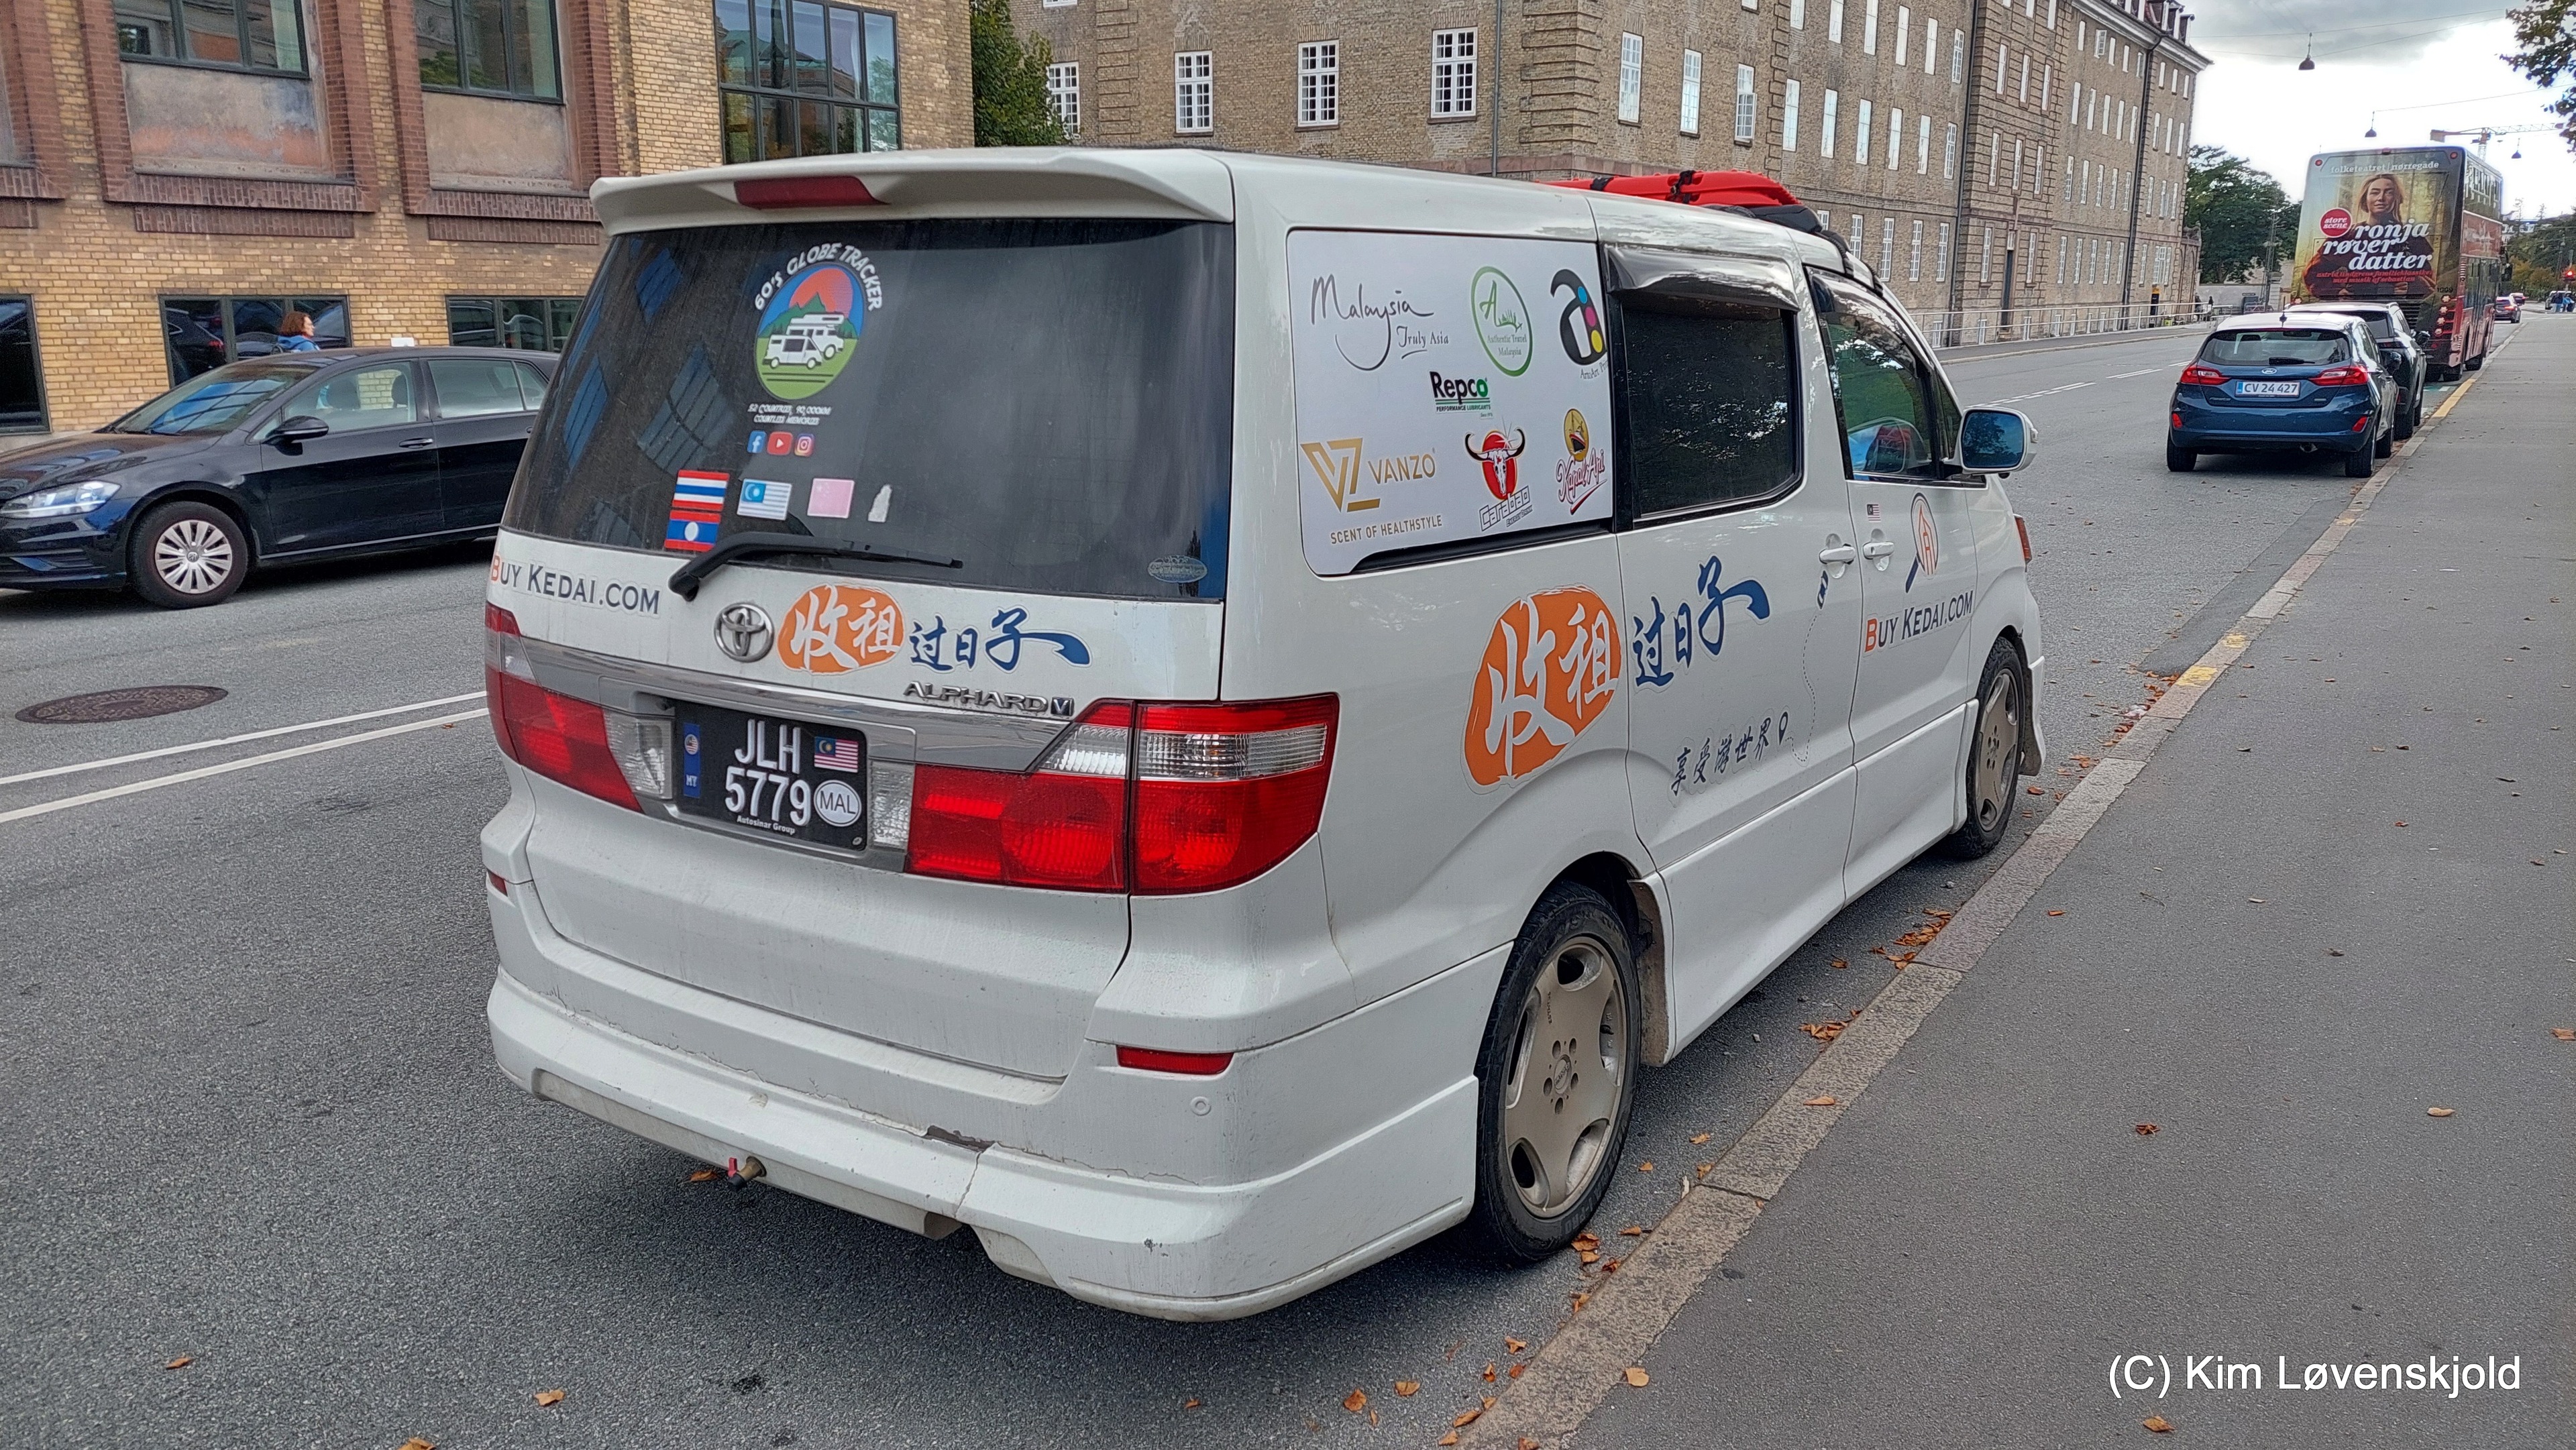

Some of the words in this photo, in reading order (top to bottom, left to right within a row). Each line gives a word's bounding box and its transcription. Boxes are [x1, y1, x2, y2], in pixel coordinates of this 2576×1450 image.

[2330, 164, 2385, 174] folketeatret
[2392, 161, 2439, 171] nørregade
[2354, 219, 2430, 244] ronja
[2323, 238, 2397, 256] røver
[2348, 252, 2433, 270] datter
[786, 242, 842, 276] GLOBE
[839, 244, 883, 312] TRACKER
[1311, 273, 1434, 371] Malaysia
[1396, 325, 1427, 349] Truly
[1429, 334, 1450, 345] Asia
[1487, 335, 1511, 343] Authentic
[1511, 334, 1527, 343] Travel
[1499, 347, 1522, 359] Malaysia
[1429, 371, 1488, 405] Repco
[2245, 383, 2259, 393] CV
[2261, 383, 2275, 393] 24
[2277, 383, 2298, 393] 427
[1366, 453, 1437, 485] VANZO
[1556, 455, 1586, 505] Kapal
[1586, 447, 1605, 485] Api
[1479, 485, 1531, 531] Carabao
[1330, 527, 1363, 545] SCENT
[1366, 526, 1379, 541] OF
[1381, 514, 1443, 536] HEALTHSTYLE
[903, 680, 1049, 712] ALPHARD
[735, 718, 802, 775] JLH
[686, 774, 698, 788] MY
[724, 765, 812, 827] 5779
[820, 790, 857, 815] MAL
[737, 814, 773, 830] Autosinar
[773, 822, 796, 836] Group
